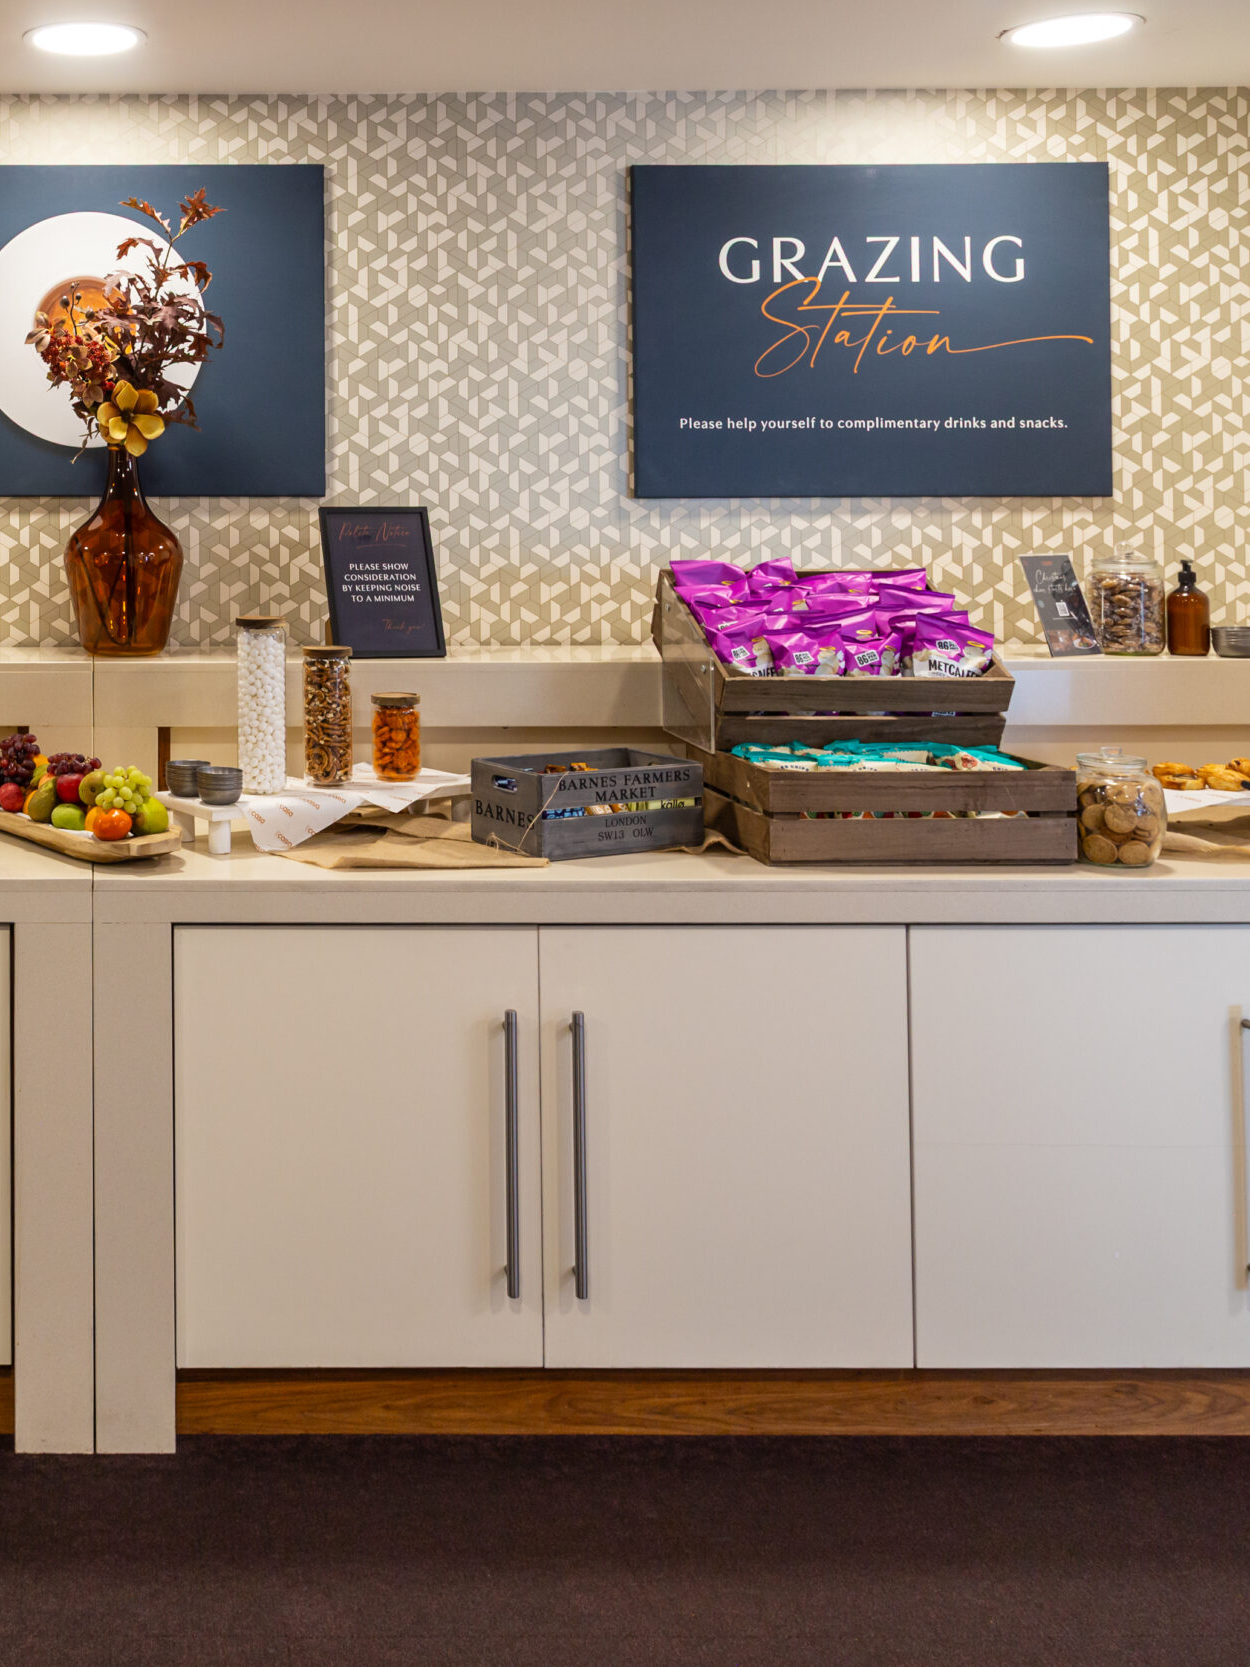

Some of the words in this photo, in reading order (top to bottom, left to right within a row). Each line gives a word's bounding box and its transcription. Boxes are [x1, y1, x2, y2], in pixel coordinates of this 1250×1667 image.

[718, 235, 1025, 284] GRAZING
[754, 276, 1095, 378] Station
[679, 417, 723, 430] Please
[727, 417, 757, 432] help
[760, 417, 816, 433] yourself
[819, 418, 834, 429] to
[837, 416, 941, 432] complimentary
[944, 416, 987, 429] drinks
[990, 416, 1016, 429] and
[1019, 416, 1068, 429] snacks.
[349, 563, 380, 571] PLEASE
[382, 563, 409, 571] SHOW
[344, 573, 417, 582] CONSIDERATION
[342, 584, 353, 592] BY
[355, 584, 393, 592] KEEPING
[394, 584, 421, 592] NOISE
[856, 654, 869, 666] 86
[557, 776, 617, 792] BARNES
[623, 769, 691, 786] FARMERS
[595, 786, 657, 803] MARKET
[475, 799, 536, 832] BARNES
[605, 816, 647, 828] LONDON
[597, 830, 625, 842] SW13
